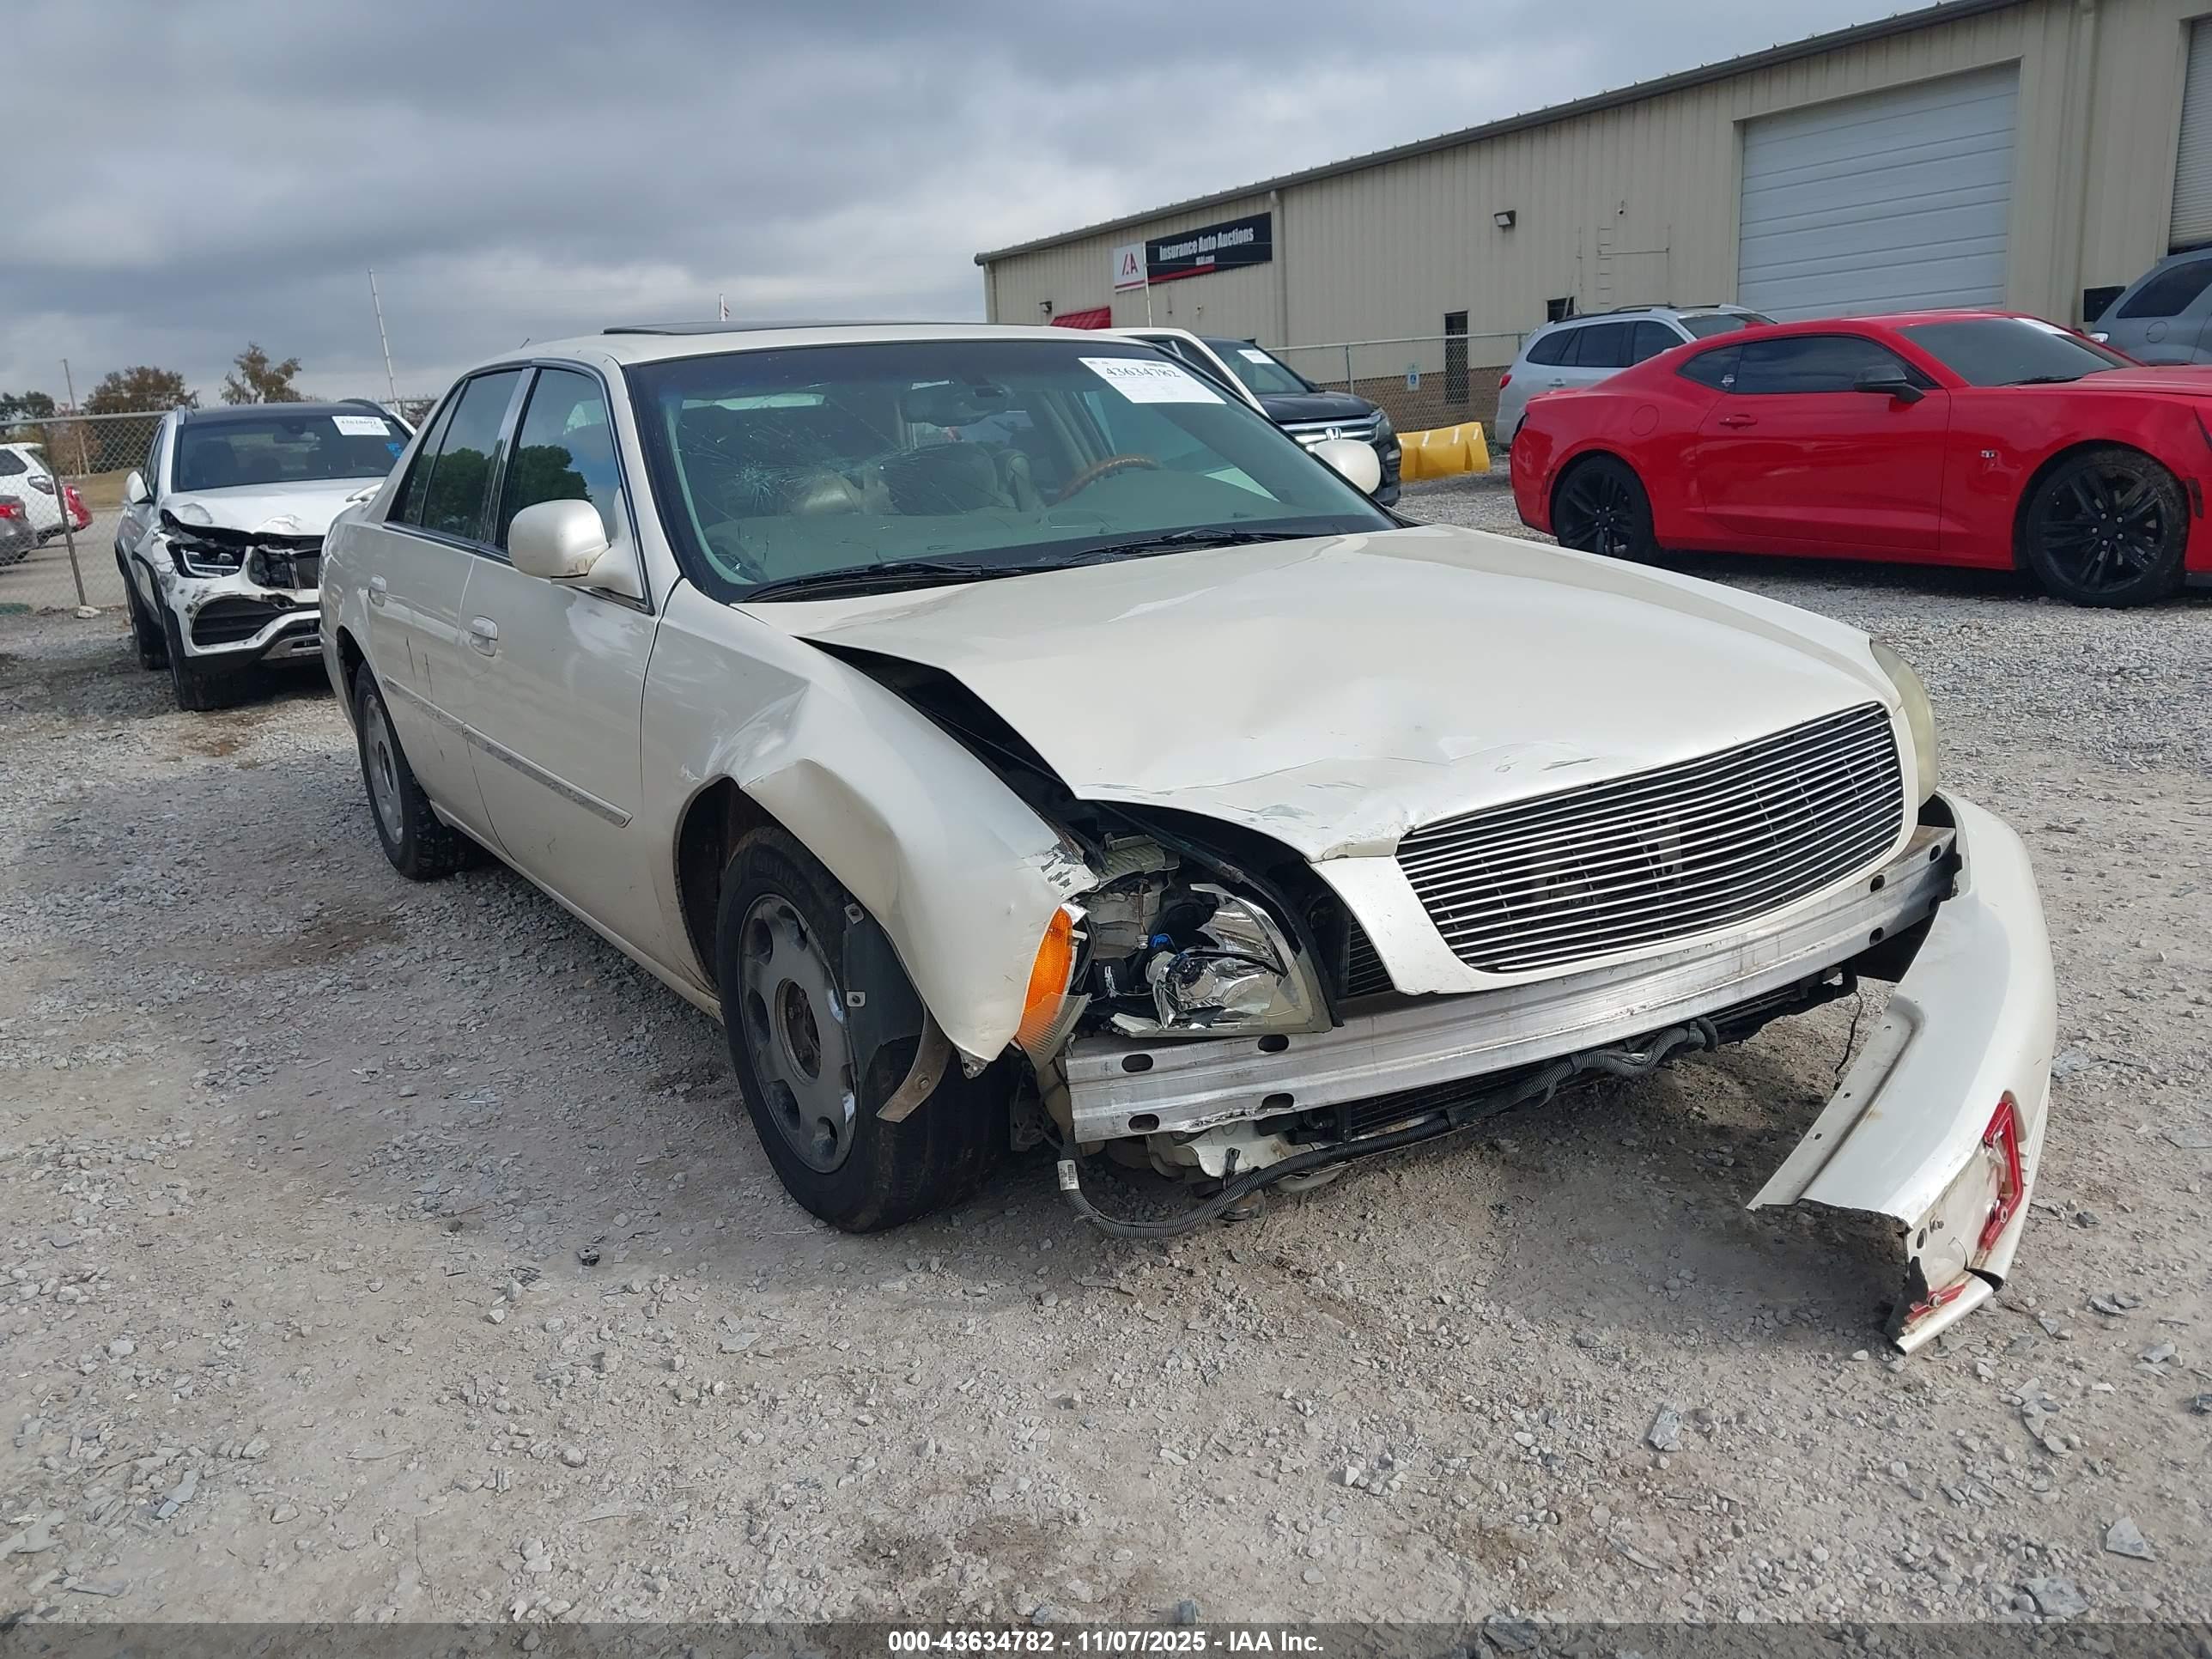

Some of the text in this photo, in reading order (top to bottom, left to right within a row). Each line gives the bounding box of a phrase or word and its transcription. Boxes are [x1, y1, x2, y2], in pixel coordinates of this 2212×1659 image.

[1159, 227, 1255, 261] Insurance Auto Auctions
[1106, 367, 1182, 378] 43634782
